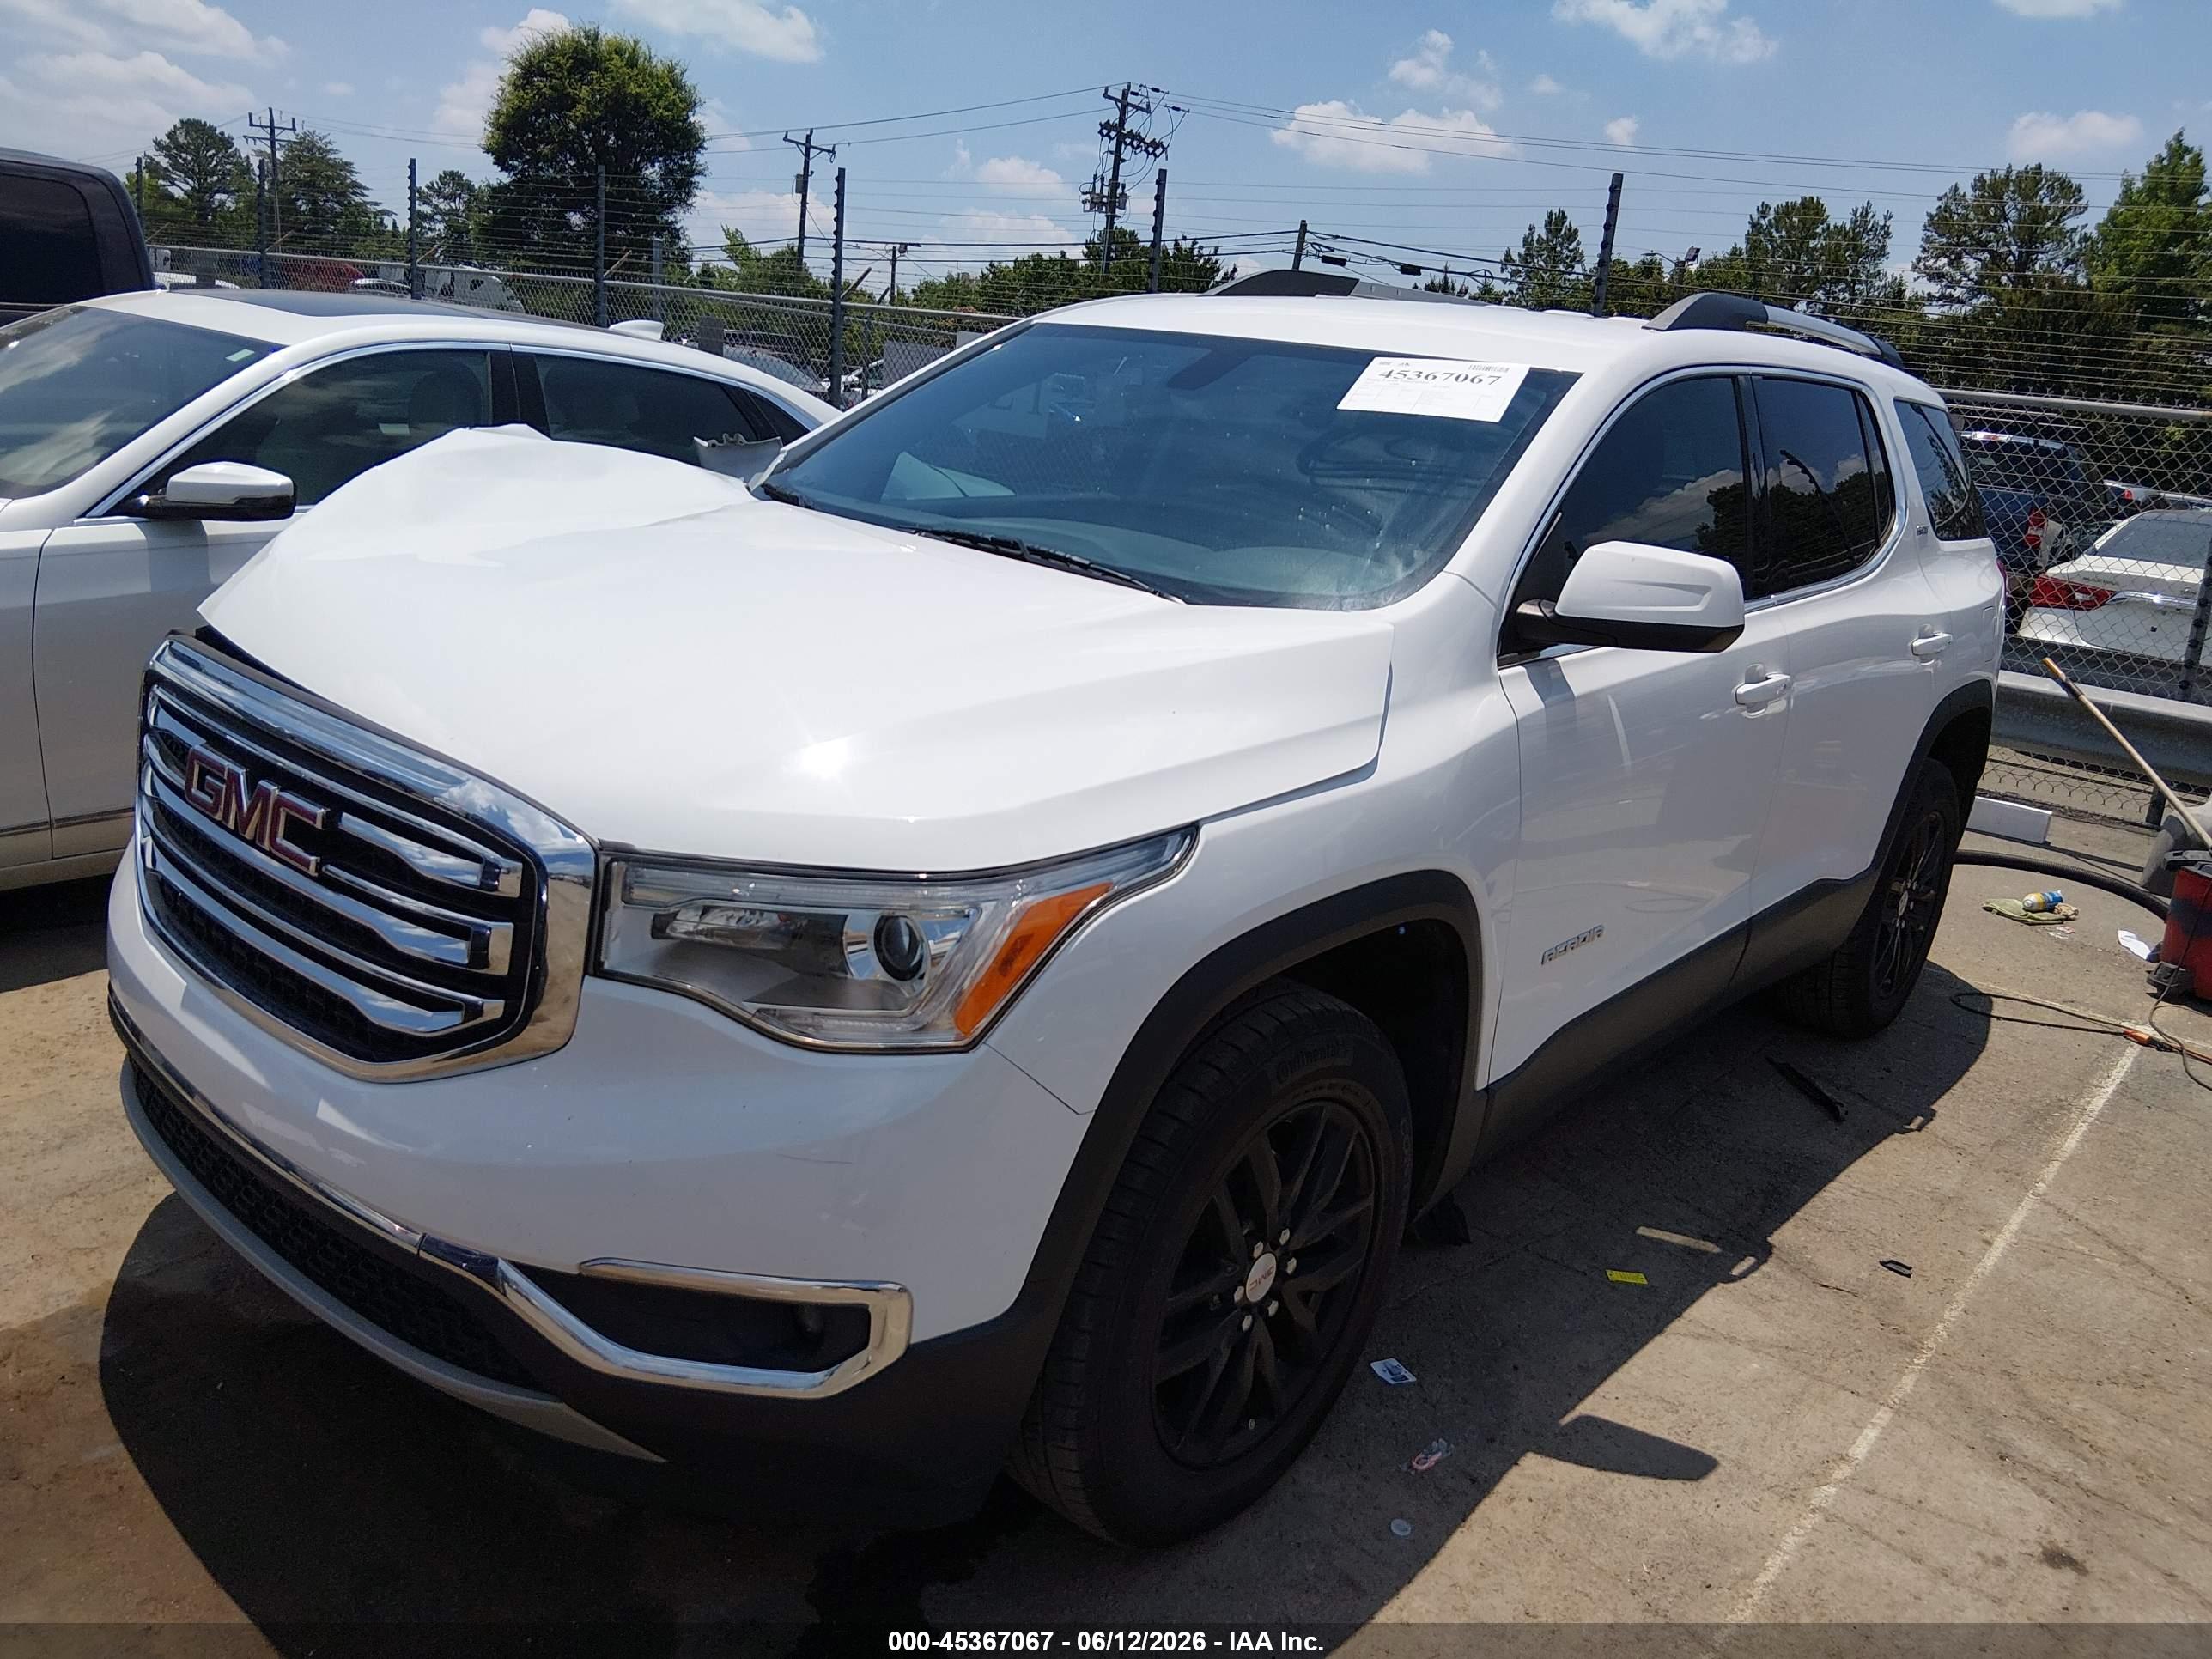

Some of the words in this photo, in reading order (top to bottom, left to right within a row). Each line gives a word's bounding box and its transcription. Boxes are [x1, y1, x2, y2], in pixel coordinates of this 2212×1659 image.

[1378, 369, 1503, 386] 45367067
[185, 744, 330, 877] GMC
[1540, 924, 1606, 965] ACADIA
[1249, 1264, 1274, 1291] GMC
